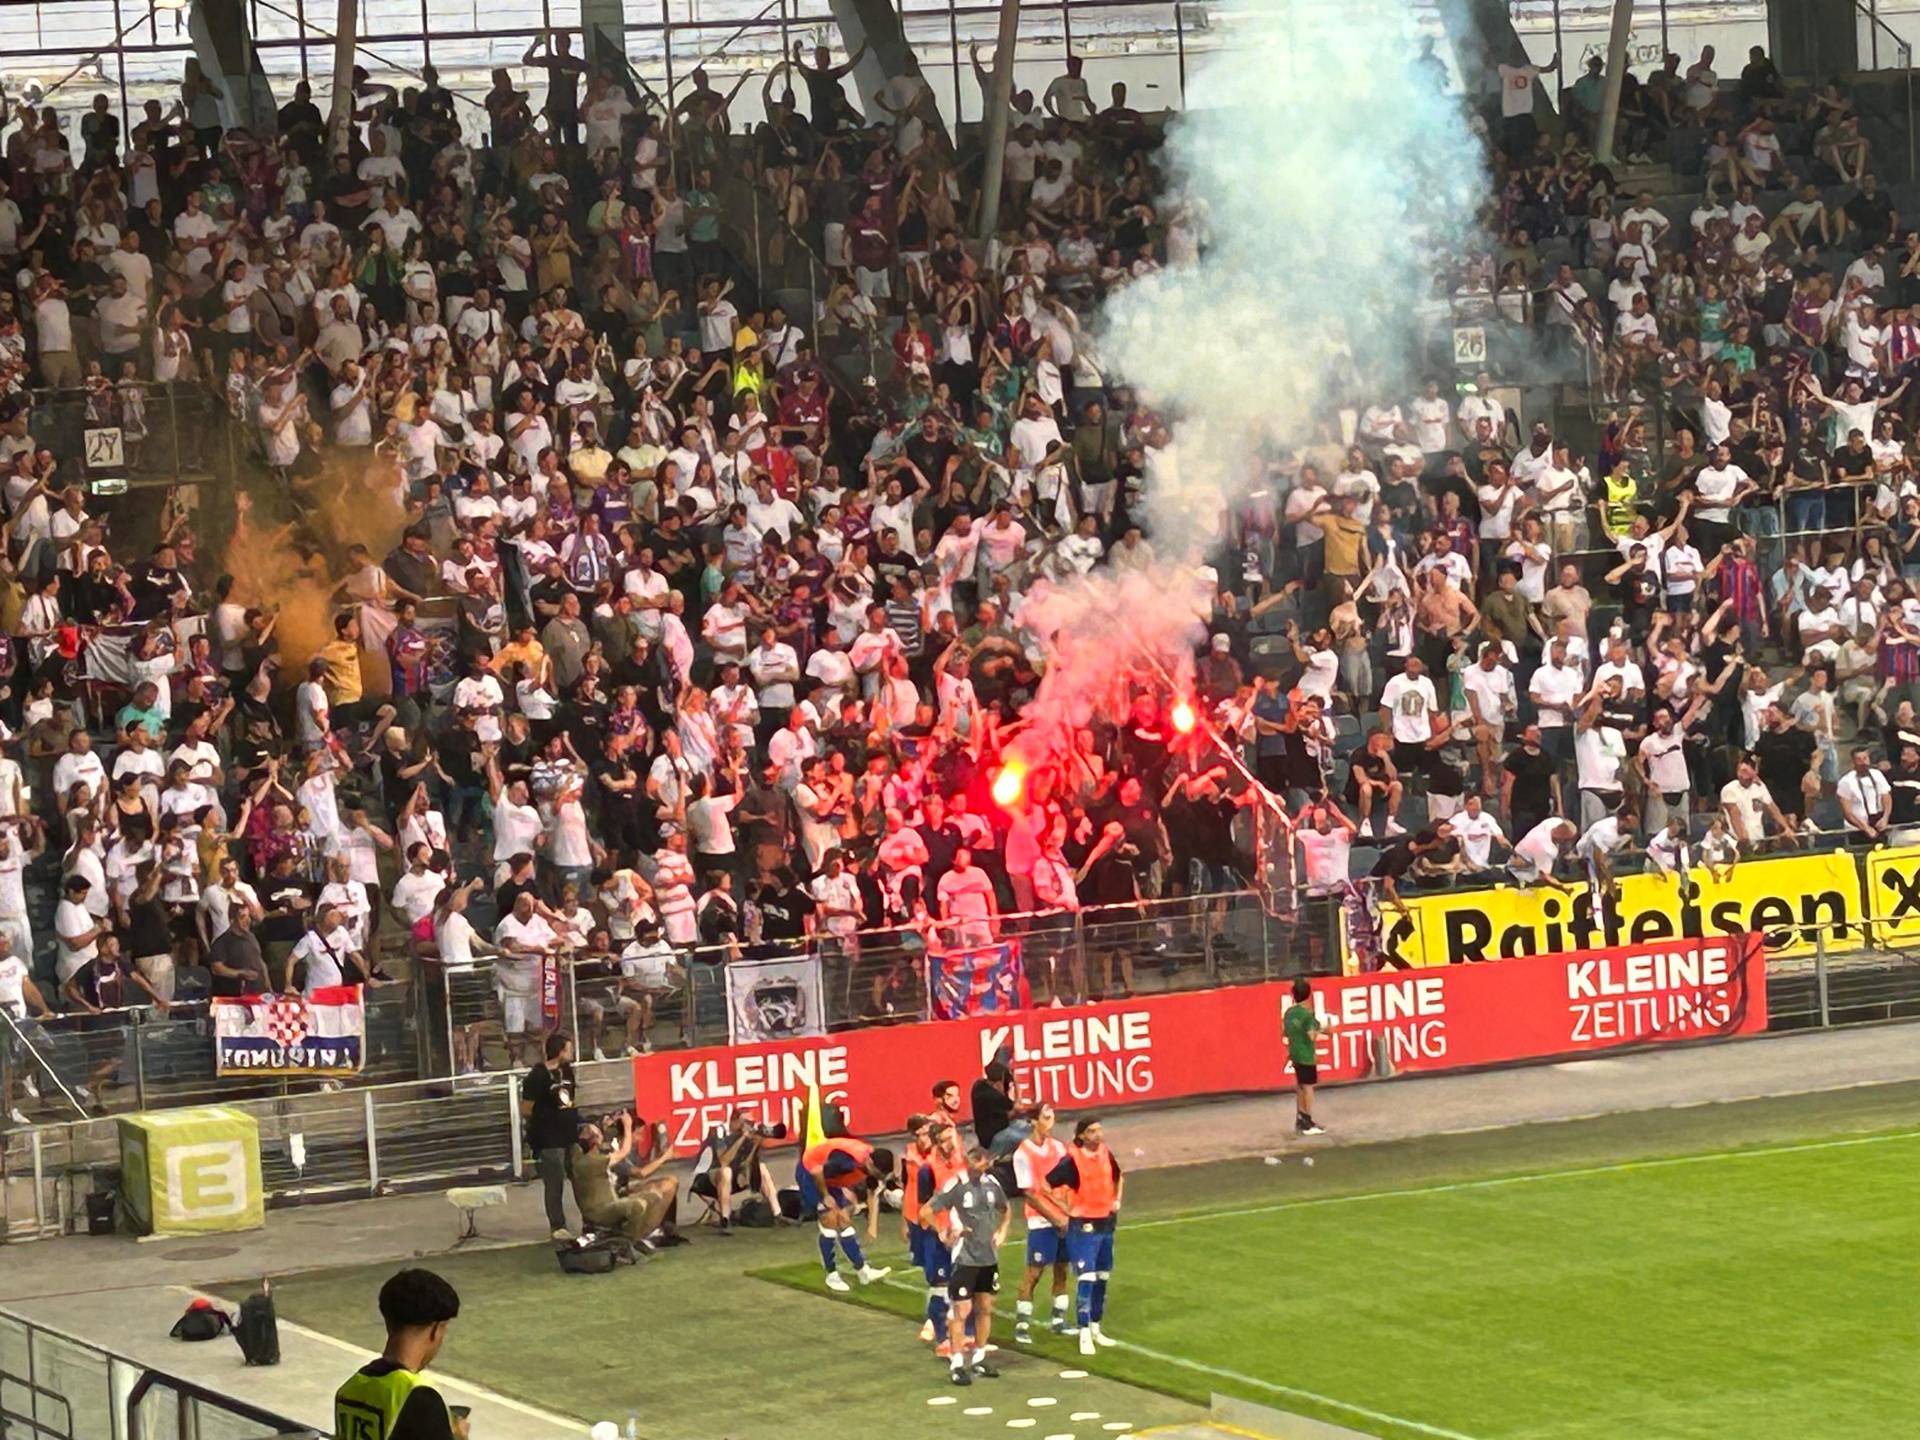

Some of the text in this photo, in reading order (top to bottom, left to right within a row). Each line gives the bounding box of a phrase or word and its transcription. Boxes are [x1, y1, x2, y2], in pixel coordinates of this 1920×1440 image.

[1446, 881, 1848, 965] Raiffeisen
[1567, 947, 1729, 1000] KLEINE
[1568, 990, 1731, 1042] ZEITUNG
[670, 1046, 849, 1103] KLEINE
[1282, 1020, 1447, 1075] EITUNG
[1010, 1055, 1154, 1104] EITUNG
